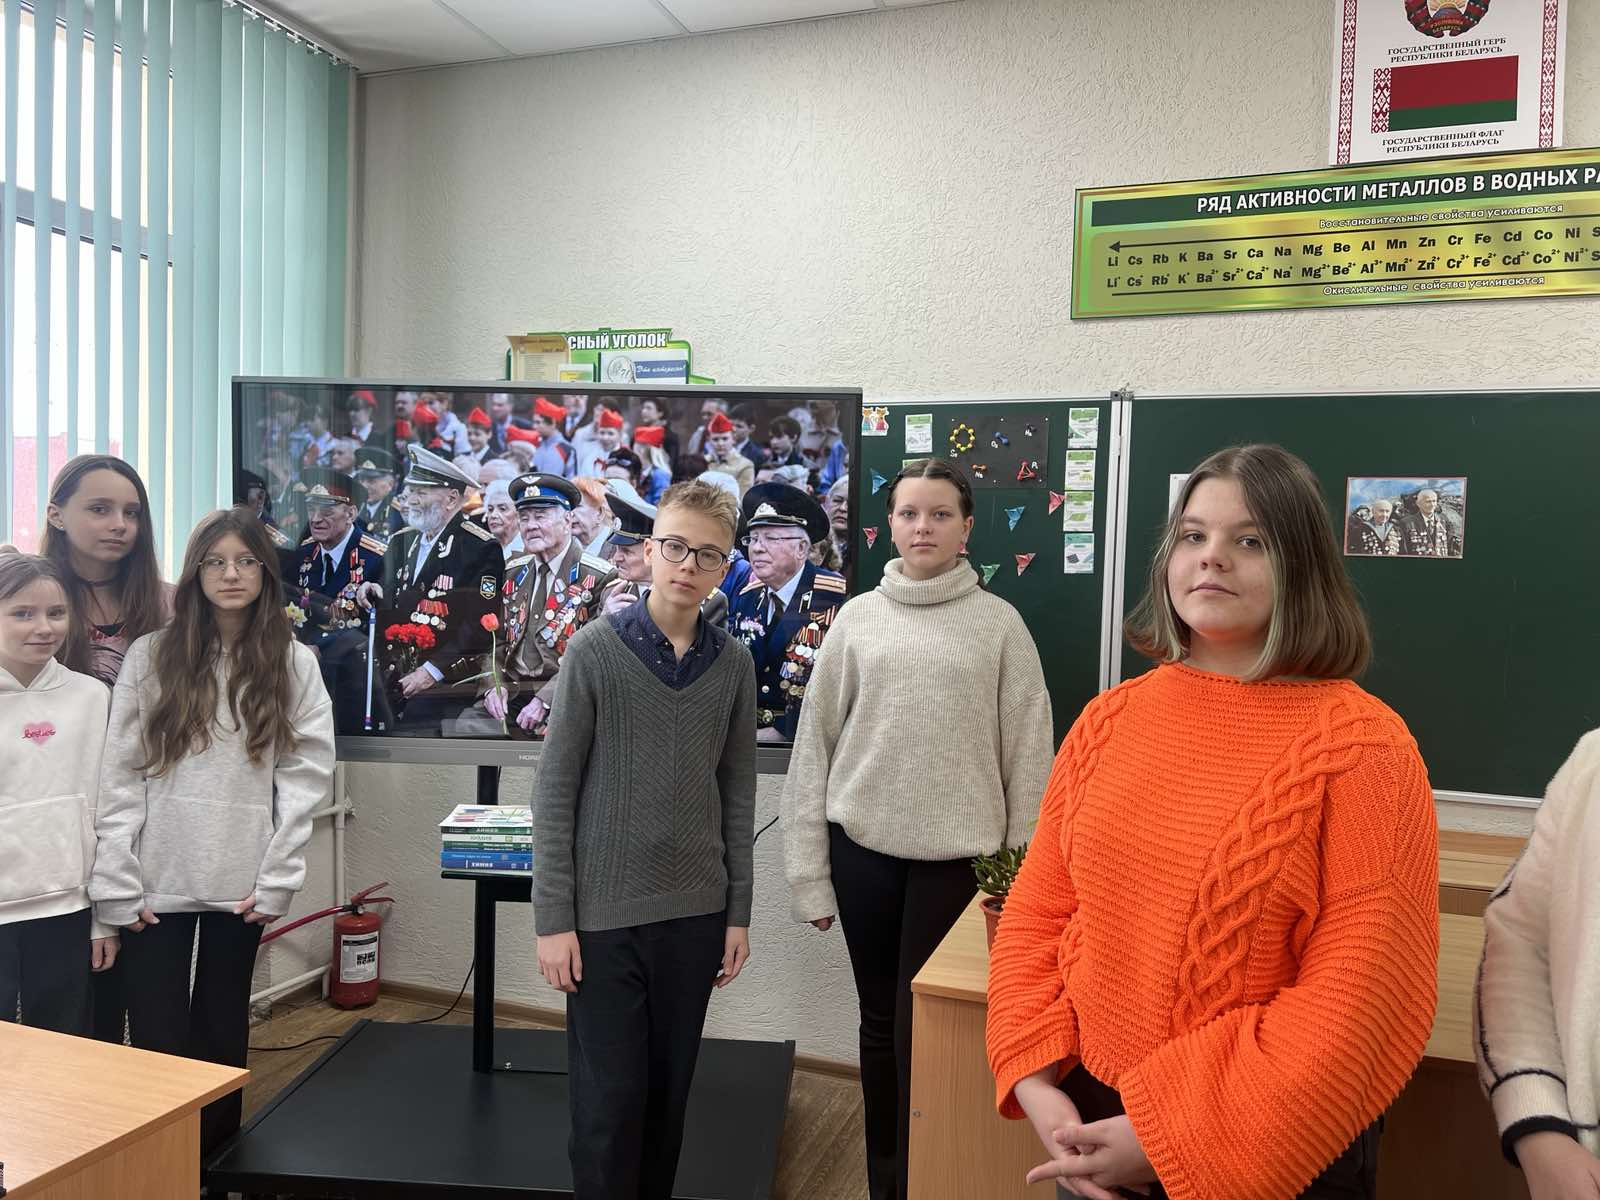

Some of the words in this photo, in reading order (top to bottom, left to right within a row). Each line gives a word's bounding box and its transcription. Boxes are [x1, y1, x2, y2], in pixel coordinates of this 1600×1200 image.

[1388, 39, 1481, 55] ГОСУДАРСТВЕННЫЙ
[1483, 38, 1506, 46] ГЕРБ
[1390, 51, 1453, 63] РЕСПУБЛИКИ
[1455, 46, 1502, 57] БЕЛАРУСЬ
[1382, 131, 1476, 146] ГОСУДАРСТВЕННЫЙ
[1478, 130, 1504, 138] ФЛАГ
[1386, 142, 1449, 153] РЕСПУБЛИКИ
[1452, 138, 1500, 148] БЕЛАРУСЬ
[1197, 196, 1232, 214] РЯД
[1236, 186, 1356, 210] АКТИВНОСТИ
[1362, 176, 1467, 200] МЕТАЛЛОВ
[1473, 175, 1486, 191] В
[1491, 168, 1578, 190] ВОДНЫХ
[1320, 213, 1428, 228] Восстановительные
[1431, 208, 1484, 222] свойства
[1486, 204, 1564, 218] усиливаются
[1108, 257, 1118, 266] Li
[1128, 256, 1142, 266] Cs
[1153, 254, 1168, 264] Rb
[1179, 252, 1188, 262] K
[1198, 252, 1214, 262] Ba
[1224, 250, 1237, 260] Sr
[1248, 248, 1264, 258] Ca
[1274, 246, 1292, 257] Na
[1302, 244, 1322, 256] Mg
[1333, 242, 1350, 253] Be
[1362, 240, 1375, 251] Al
[1386, 239, 1407, 250] Mn
[1418, 237, 1436, 248] Zn
[1448, 235, 1463, 246] Cr
[1475, 234, 1492, 244] Fe
[1504, 231, 1522, 242] Cd
[1534, 230, 1552, 240] Co
[1566, 228, 1580, 238] Ni
[1323, 282, 1408, 296] Окислительные
[1414, 279, 1466, 290] свойства
[1469, 276, 1544, 289] усиливаются
[568, 332, 609, 349] СНЫЙ
[612, 333, 668, 348] УГОЛОК
